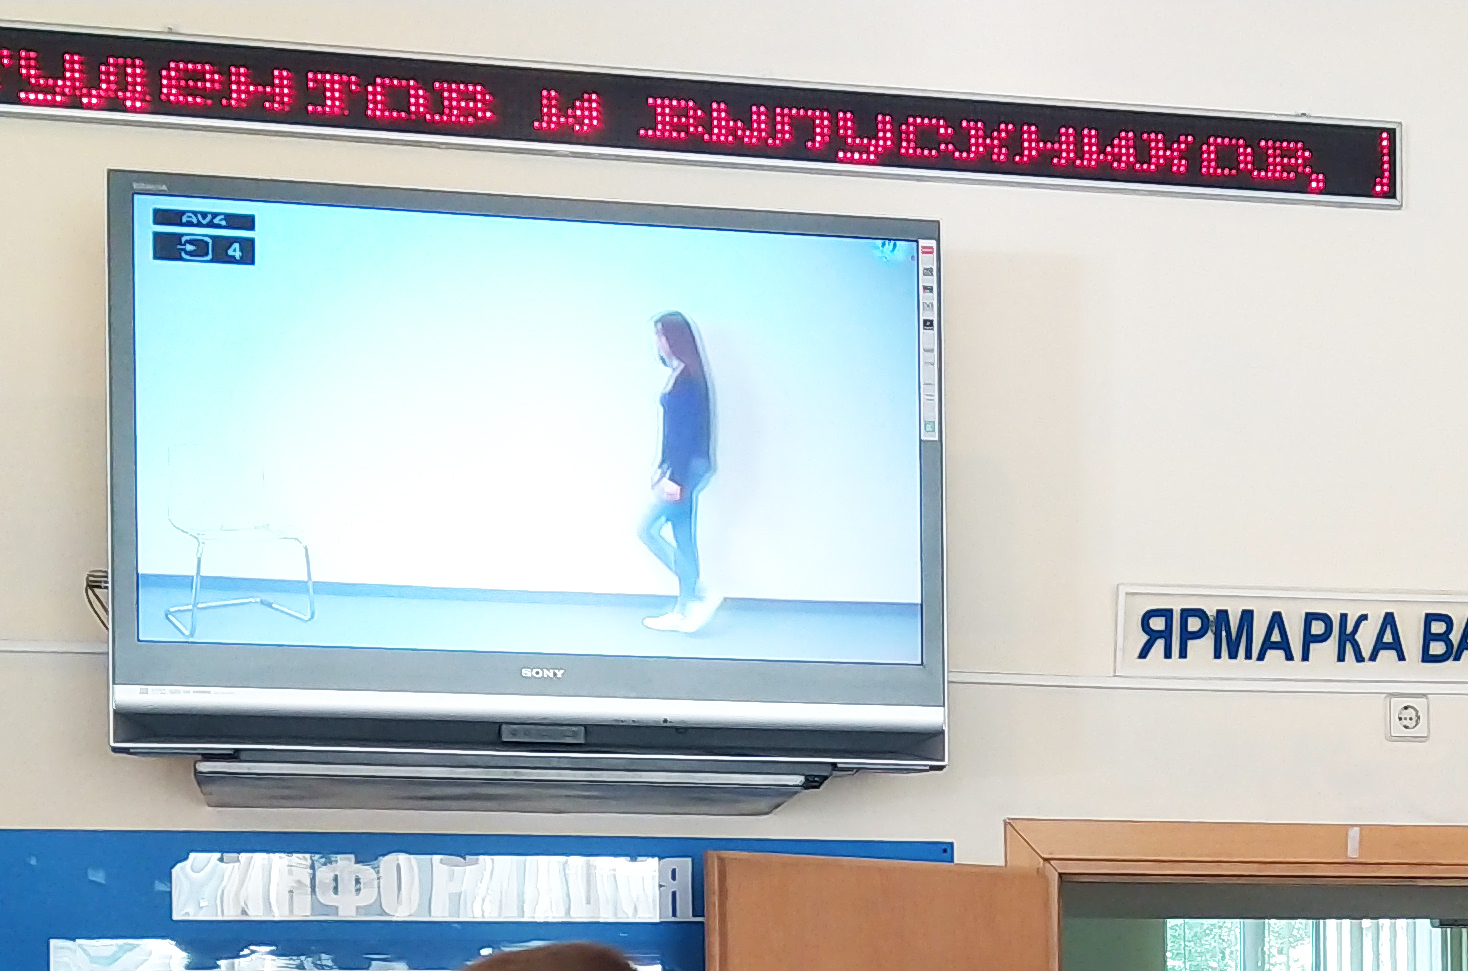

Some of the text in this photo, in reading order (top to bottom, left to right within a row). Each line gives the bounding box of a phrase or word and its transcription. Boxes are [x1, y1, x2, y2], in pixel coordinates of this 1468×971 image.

[0, 49, 495, 124] удентов
[181, 212, 227, 227] AV4
[227, 242, 243, 261] 4
[1137, 608, 1407, 664] ЯРМАРКА
[521, 668, 565, 678] SONY
